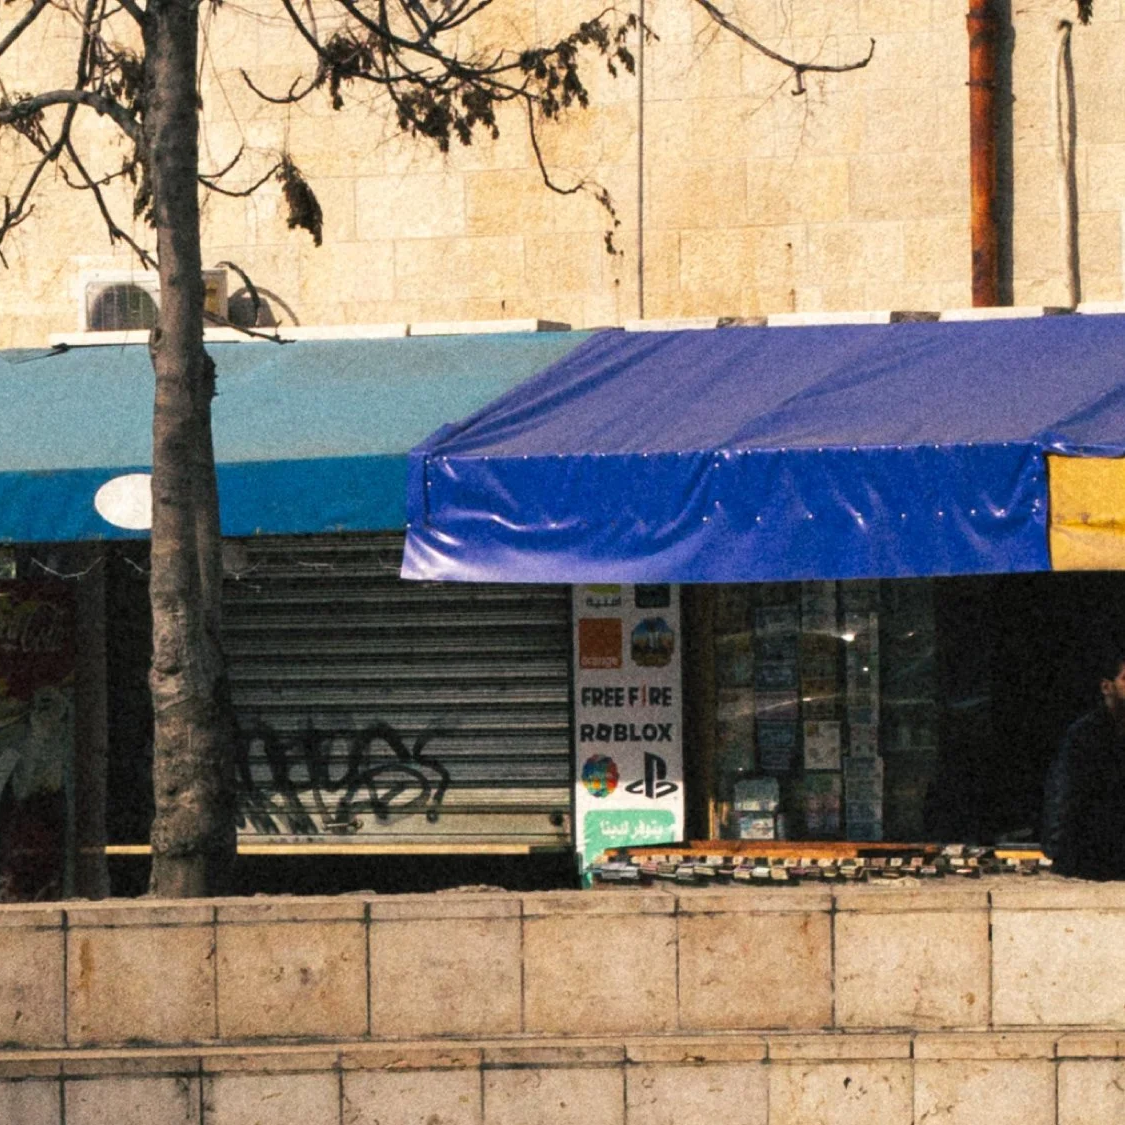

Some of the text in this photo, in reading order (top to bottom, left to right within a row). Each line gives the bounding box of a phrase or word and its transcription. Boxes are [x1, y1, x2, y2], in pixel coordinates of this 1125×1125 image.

[581, 684, 672, 708] FREE FIRE
[580, 723, 672, 743] ROBLOX
[600, 820, 629, 839] لدينا
